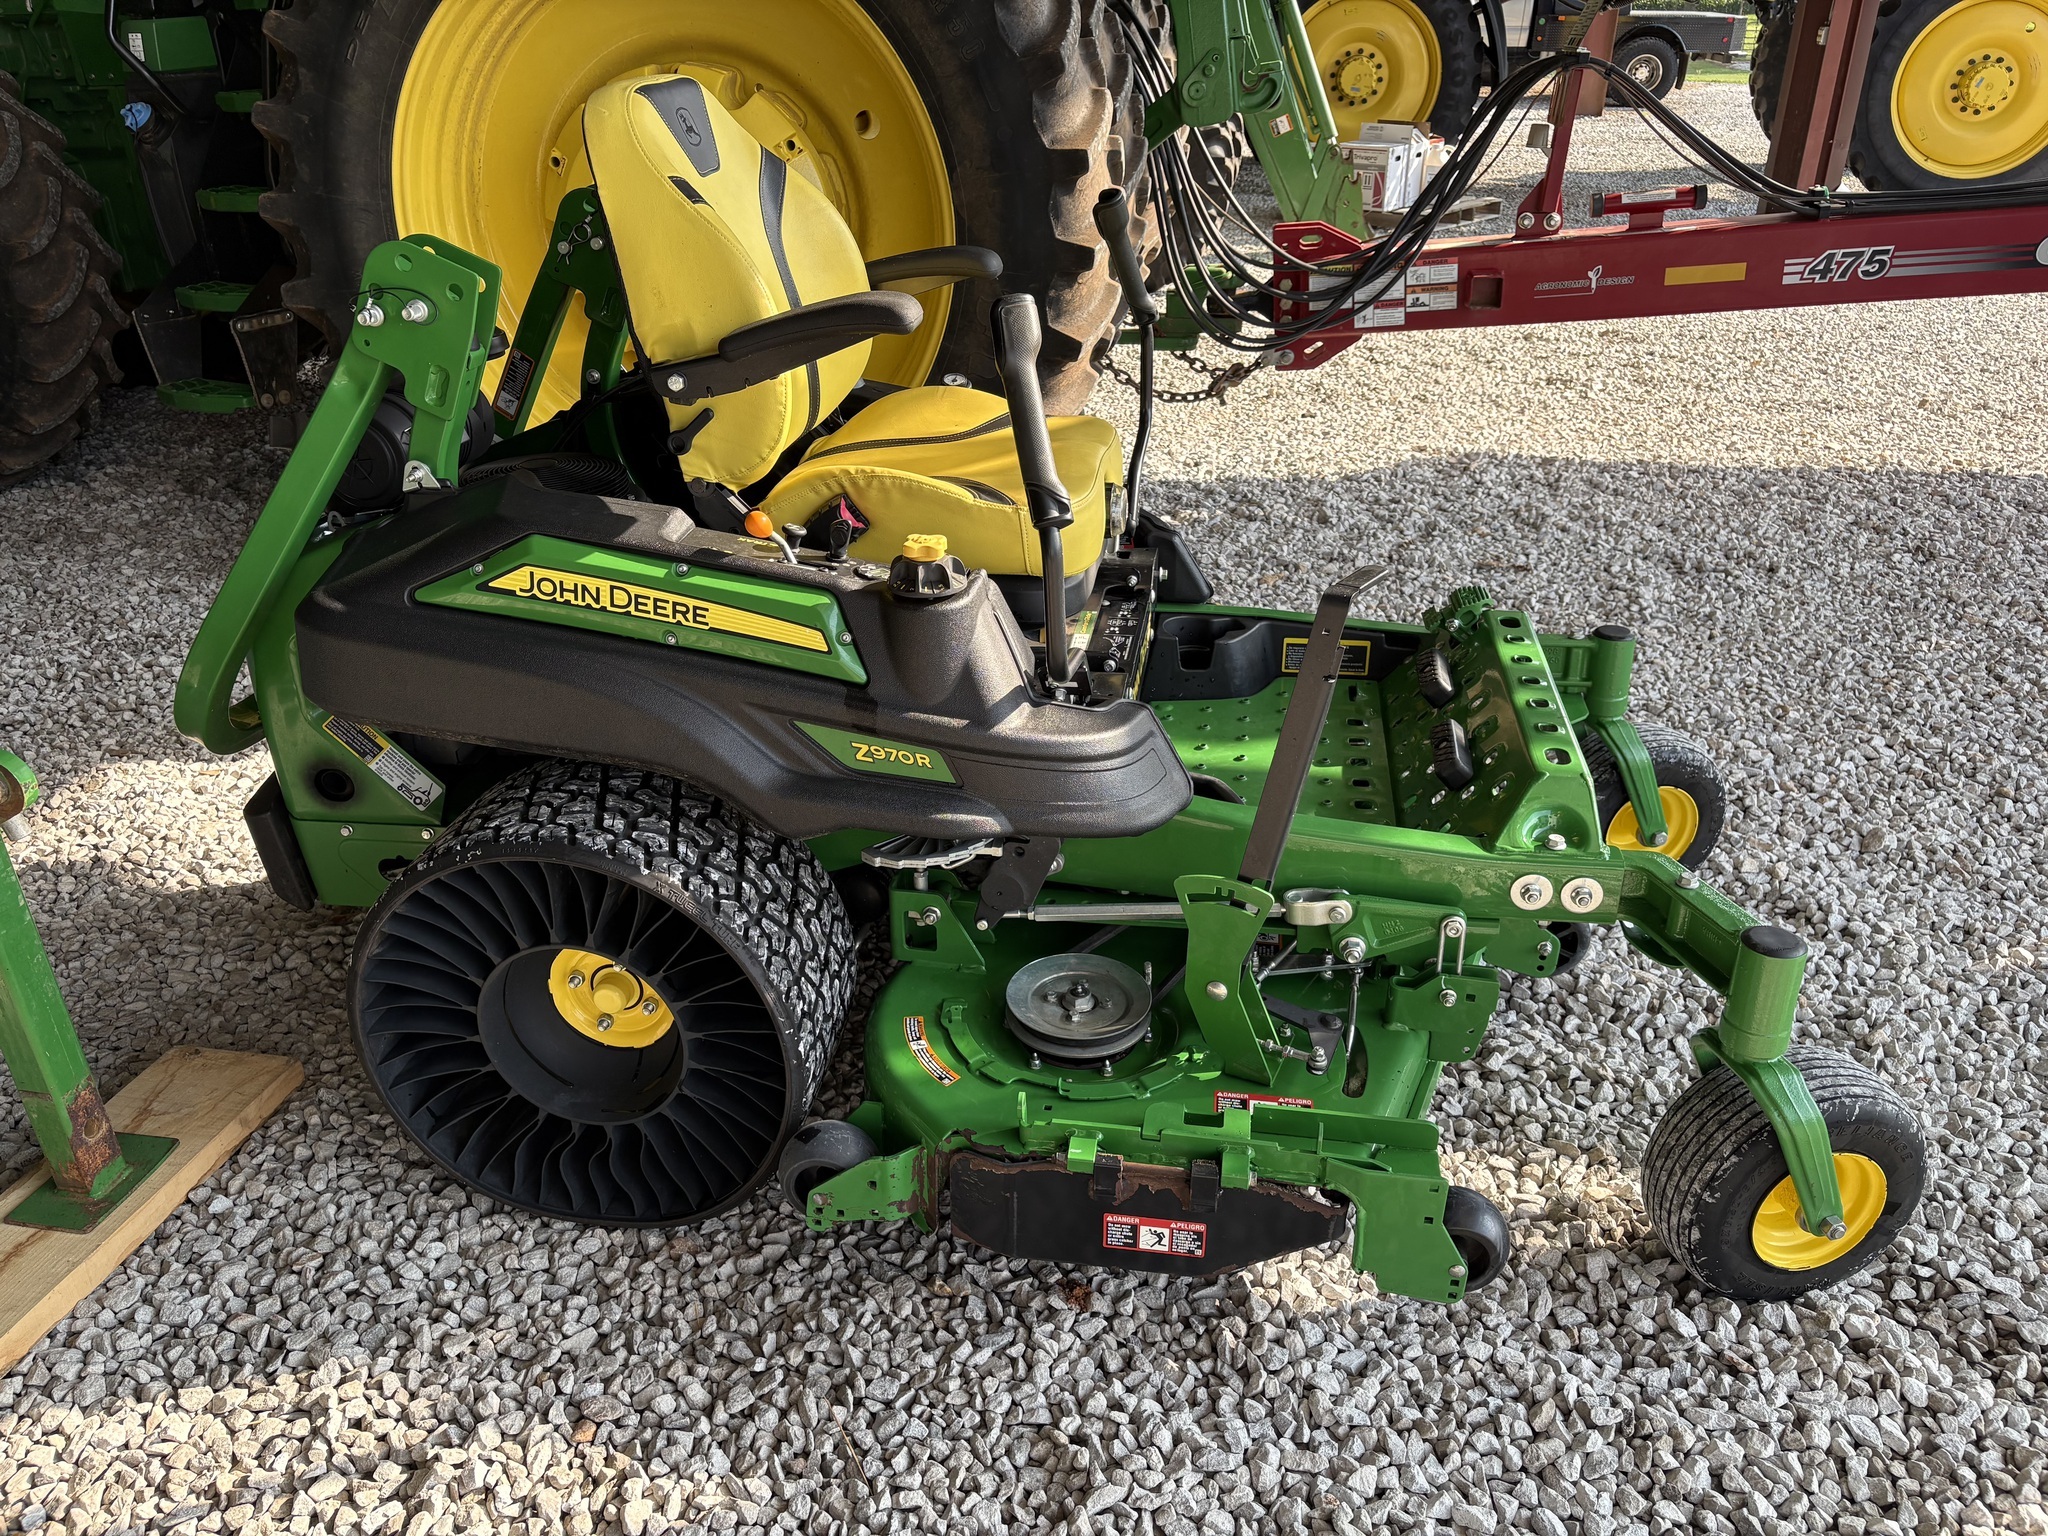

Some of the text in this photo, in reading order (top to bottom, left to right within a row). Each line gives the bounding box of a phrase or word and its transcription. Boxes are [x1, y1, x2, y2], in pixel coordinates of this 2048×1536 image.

[1353, 153, 1378, 162] Trivapro
[1422, 258, 1449, 266] DANGER
[1802, 245, 1895, 284] 475
[1535, 275, 1635, 290] AGRONOMIC DESIGN
[519, 571, 710, 627] JOHN DEERE
[850, 741, 934, 769] Z970R
[668, 888, 708, 923] TWEEL
[711, 919, 742, 950] TURF
[1223, 1091, 1249, 1099] DANGER
[1284, 1097, 1312, 1105] PELIGRO
[1113, 1215, 1140, 1224] DANGER
[1176, 1222, 1205, 1231] PELIGRO
